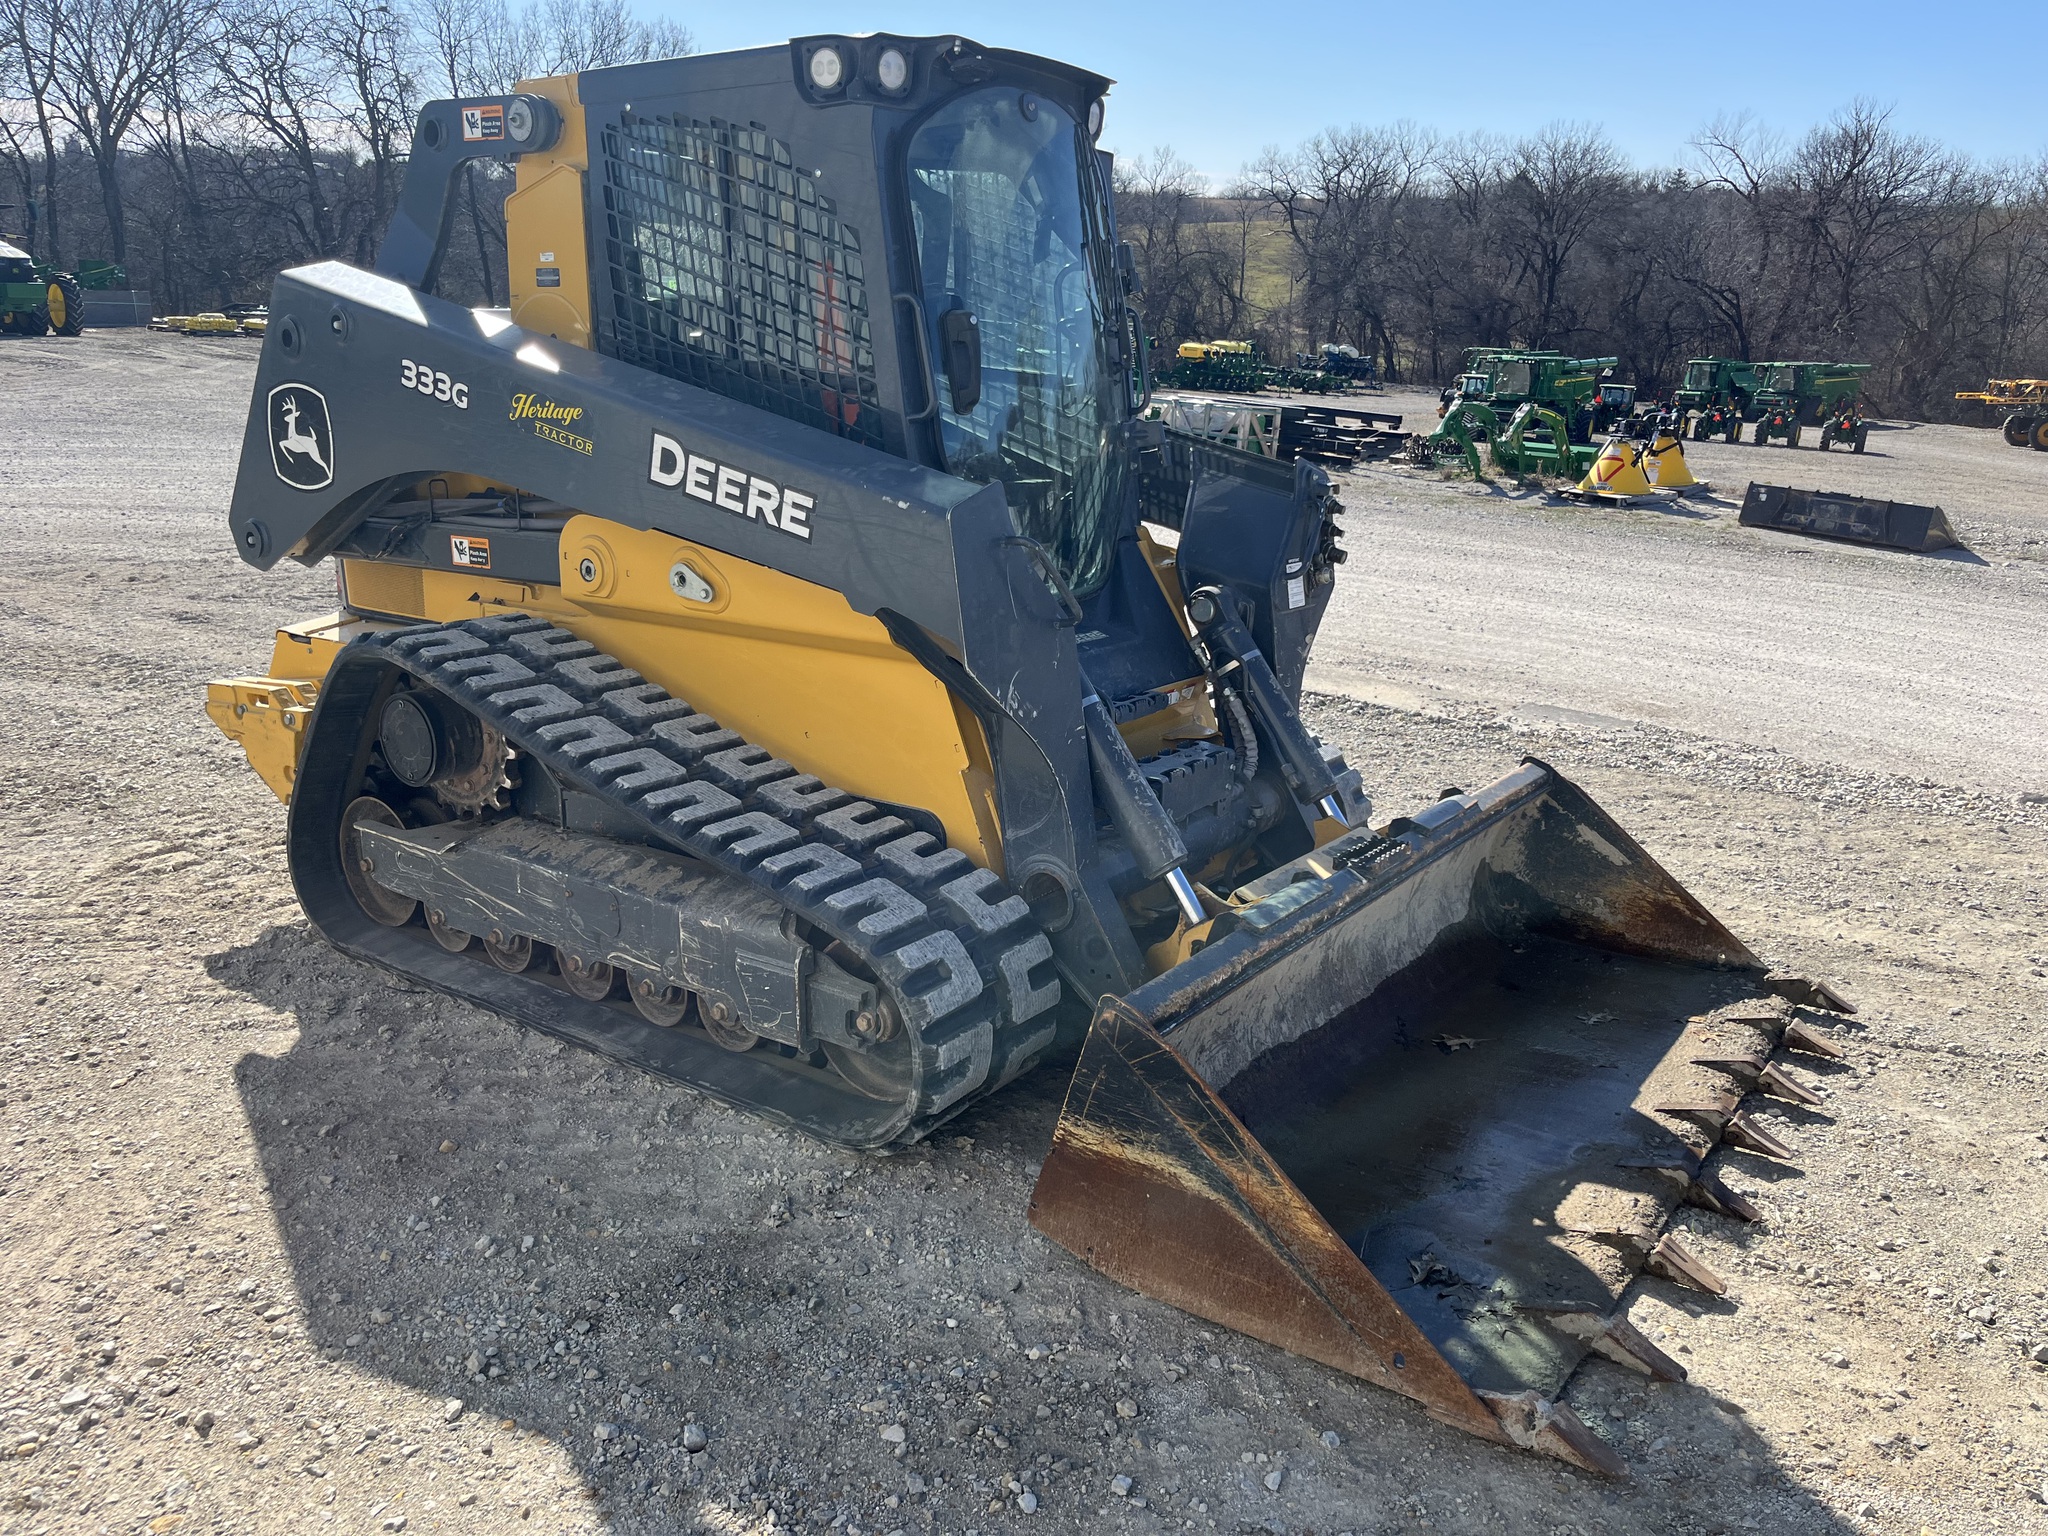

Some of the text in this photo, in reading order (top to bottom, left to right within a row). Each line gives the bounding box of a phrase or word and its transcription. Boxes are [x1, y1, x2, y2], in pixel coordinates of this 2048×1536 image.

[401, 359, 469, 409] 333G
[509, 393, 584, 426] Heritage
[535, 422, 594, 454] TRACTOR
[650, 433, 814, 539] DEERE
